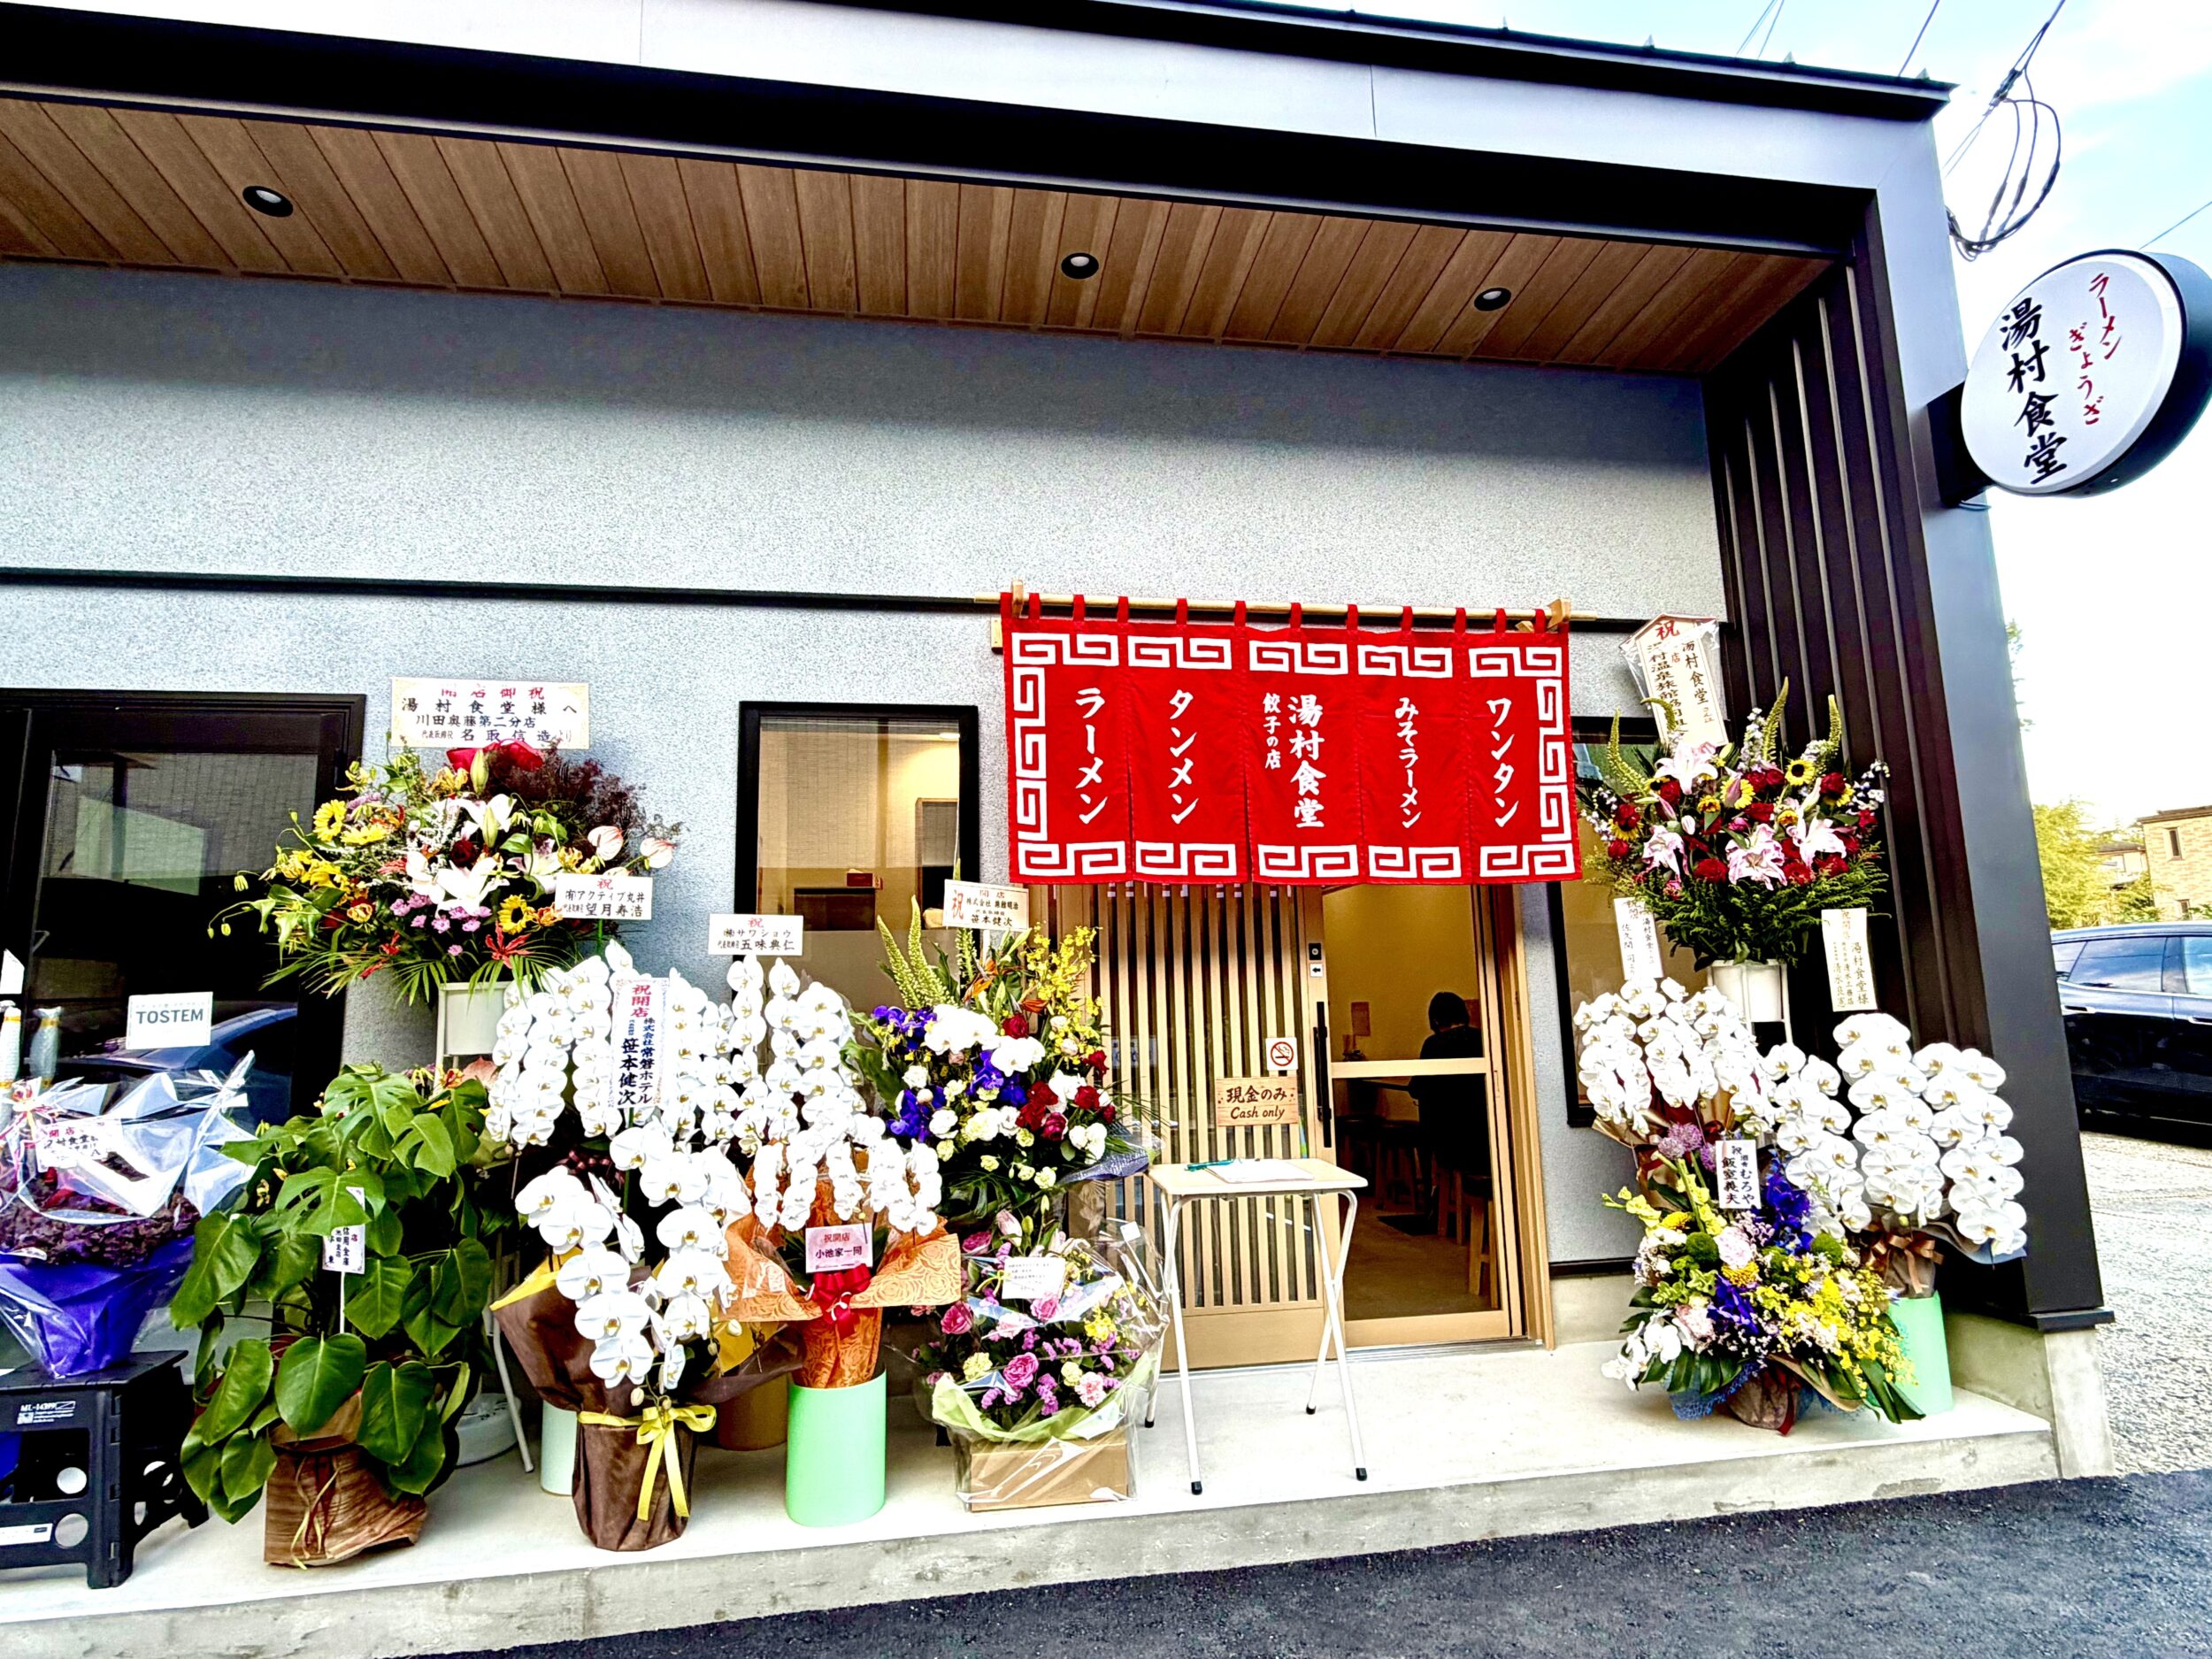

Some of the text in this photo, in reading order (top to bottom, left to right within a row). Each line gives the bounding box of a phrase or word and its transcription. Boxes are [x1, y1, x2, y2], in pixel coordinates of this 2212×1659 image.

[2088, 273, 2122, 360] ラーメン
[1999, 297, 2068, 484] 湯村食堂
[2069, 322, 2104, 425] ぎょうざ
[1655, 619, 1680, 640] 祝
[1075, 687, 1108, 825] ラーメン
[1168, 689, 1199, 825] タンメン
[1263, 693, 1281, 770] 餃子の店
[1287, 695, 1326, 828] 湯村食堂
[1394, 697, 1422, 828] みそラーメン
[1486, 698, 1519, 827] ワンタン
[135, 1009, 204, 1025] TOSTEM
[631, 984, 651, 1018] 祝開店
[1226, 1085, 1287, 1103] 現金のみ
[1230, 1105, 1285, 1121] Cash only
